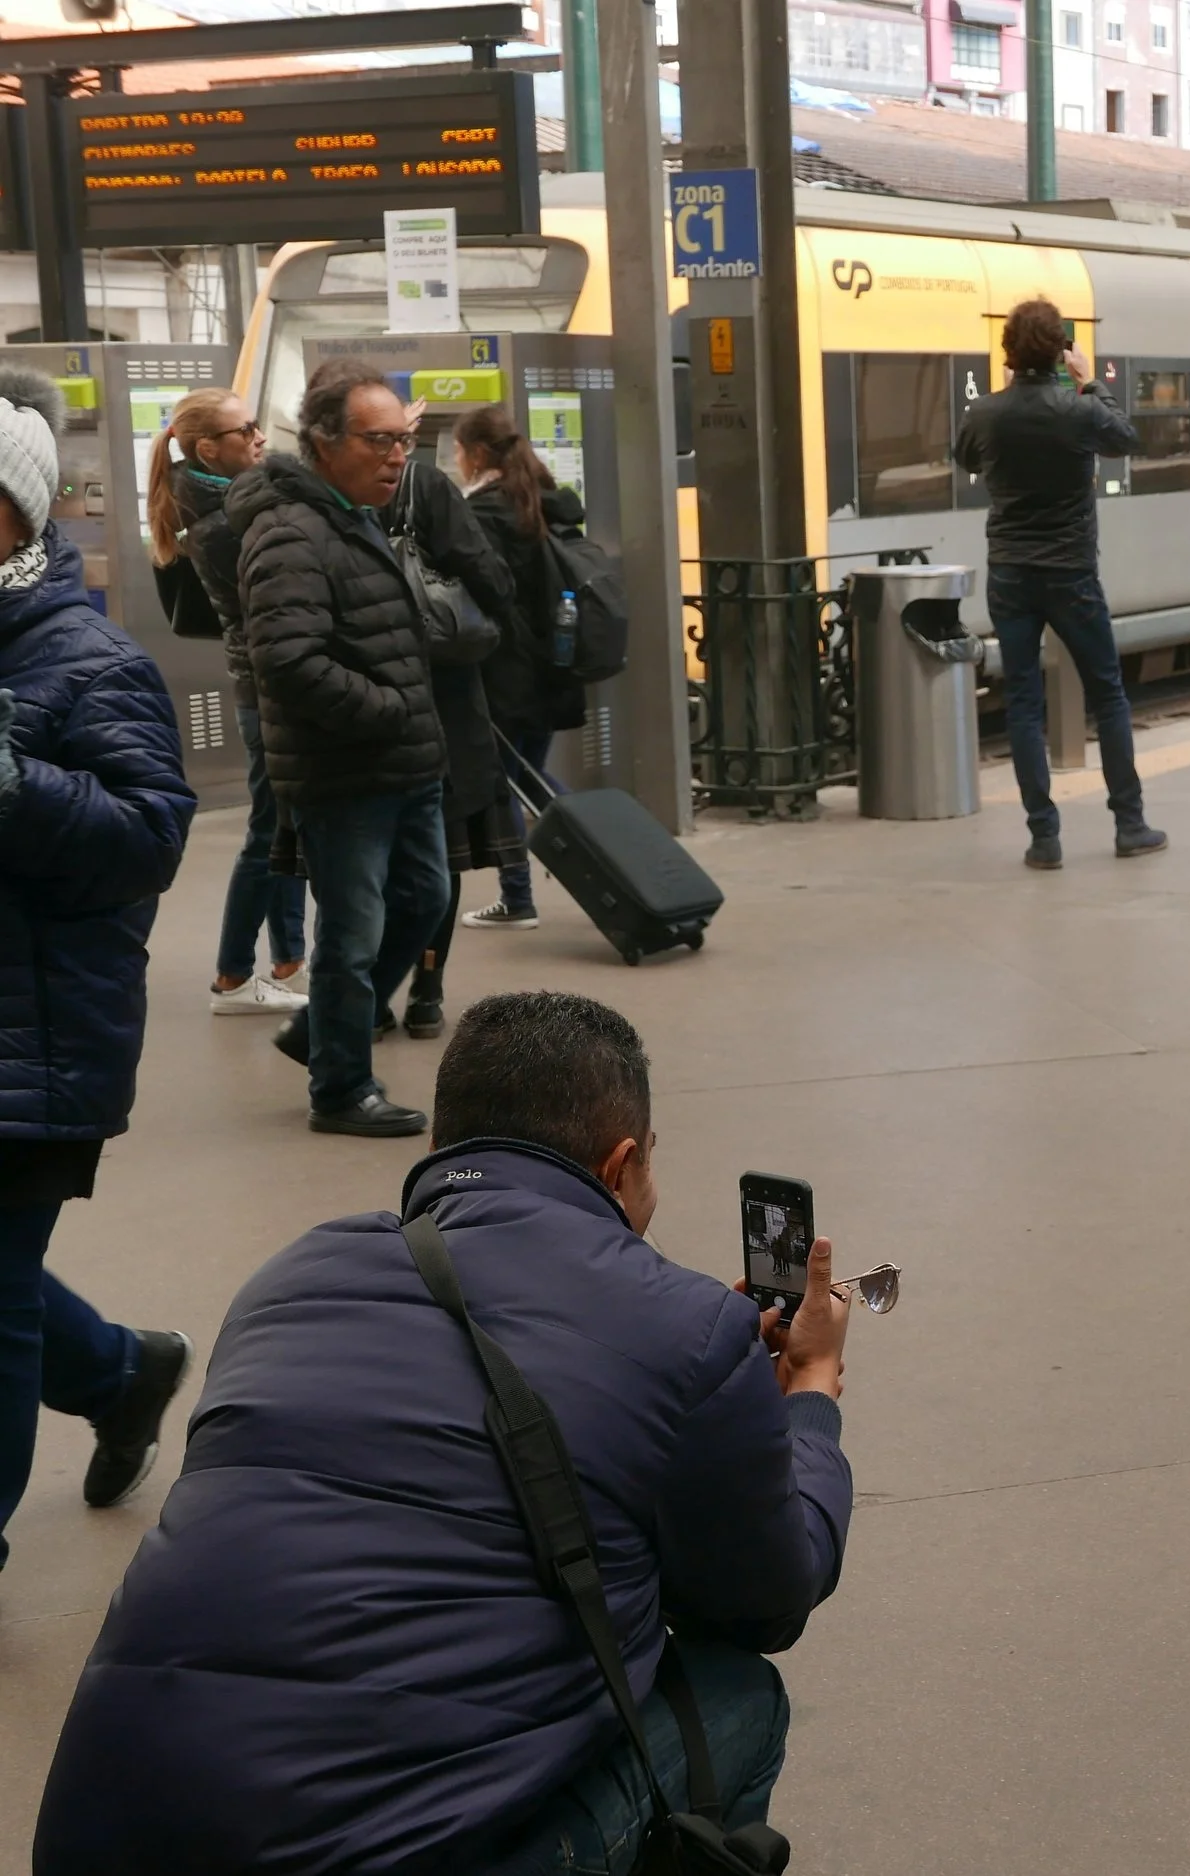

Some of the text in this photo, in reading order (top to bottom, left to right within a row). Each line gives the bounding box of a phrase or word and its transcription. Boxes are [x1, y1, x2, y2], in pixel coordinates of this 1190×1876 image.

[674, 184, 725, 204] zona
[675, 204, 725, 253] C1
[678, 256, 756, 277] andante
